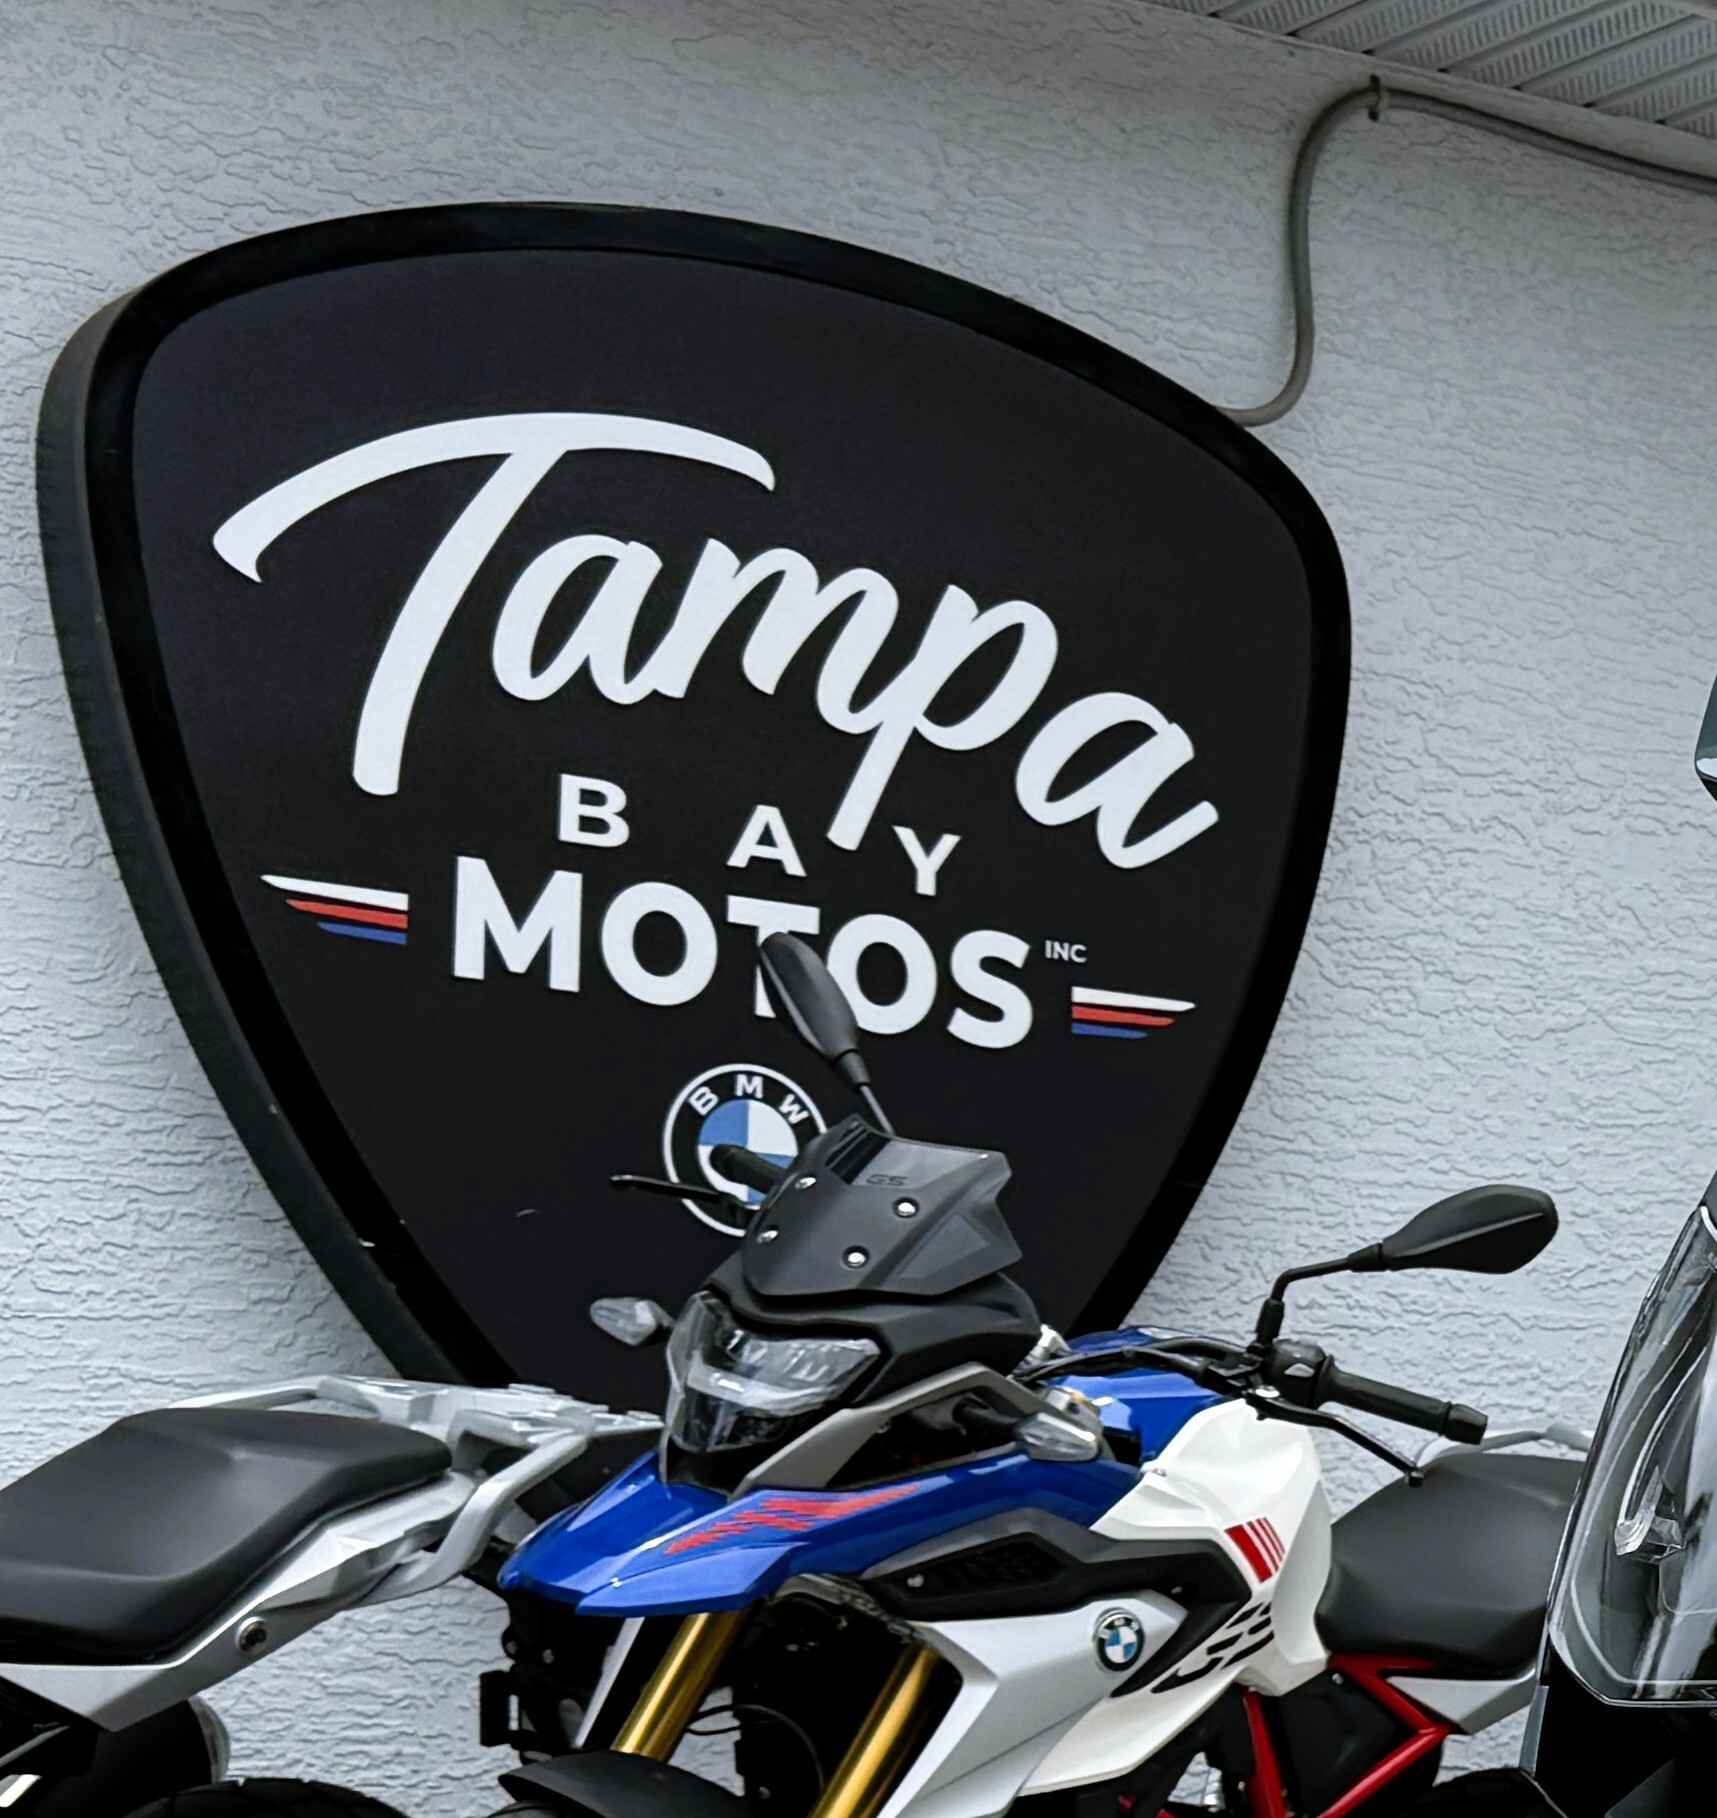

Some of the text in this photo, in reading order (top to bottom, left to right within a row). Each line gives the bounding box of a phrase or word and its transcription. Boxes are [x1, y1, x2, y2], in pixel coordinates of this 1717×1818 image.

[213, 411, 1219, 869] Tampa
[453, 855, 1087, 1049] MOTOS INC
[689, 1073, 811, 1125] BMW
